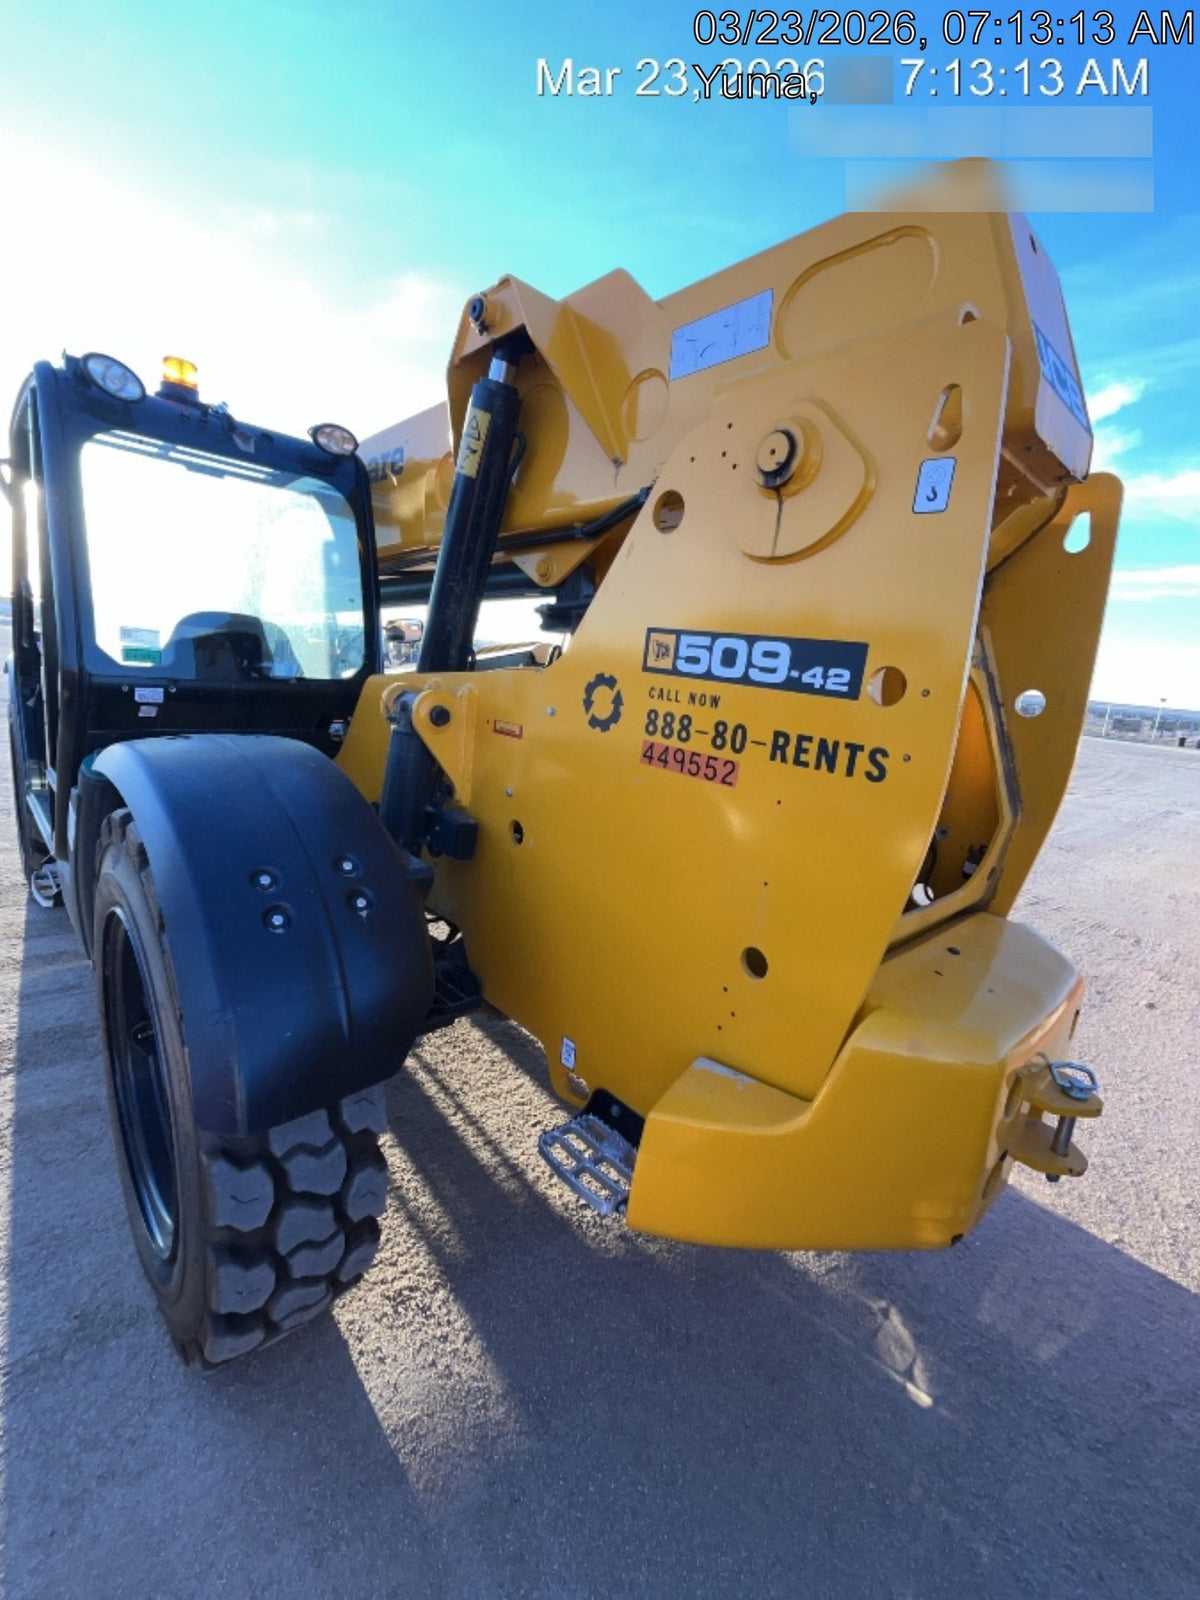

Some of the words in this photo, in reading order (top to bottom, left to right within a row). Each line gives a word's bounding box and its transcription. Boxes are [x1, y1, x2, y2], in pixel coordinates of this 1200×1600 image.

[368, 446, 404, 484] are
[676, 634, 850, 692] 509-42
[648, 687, 681, 703] CALL
[688, 691, 721, 709] NOW
[643, 742, 737, 787] 449552
[645, 709, 890, 783] 888-80-RENTS
